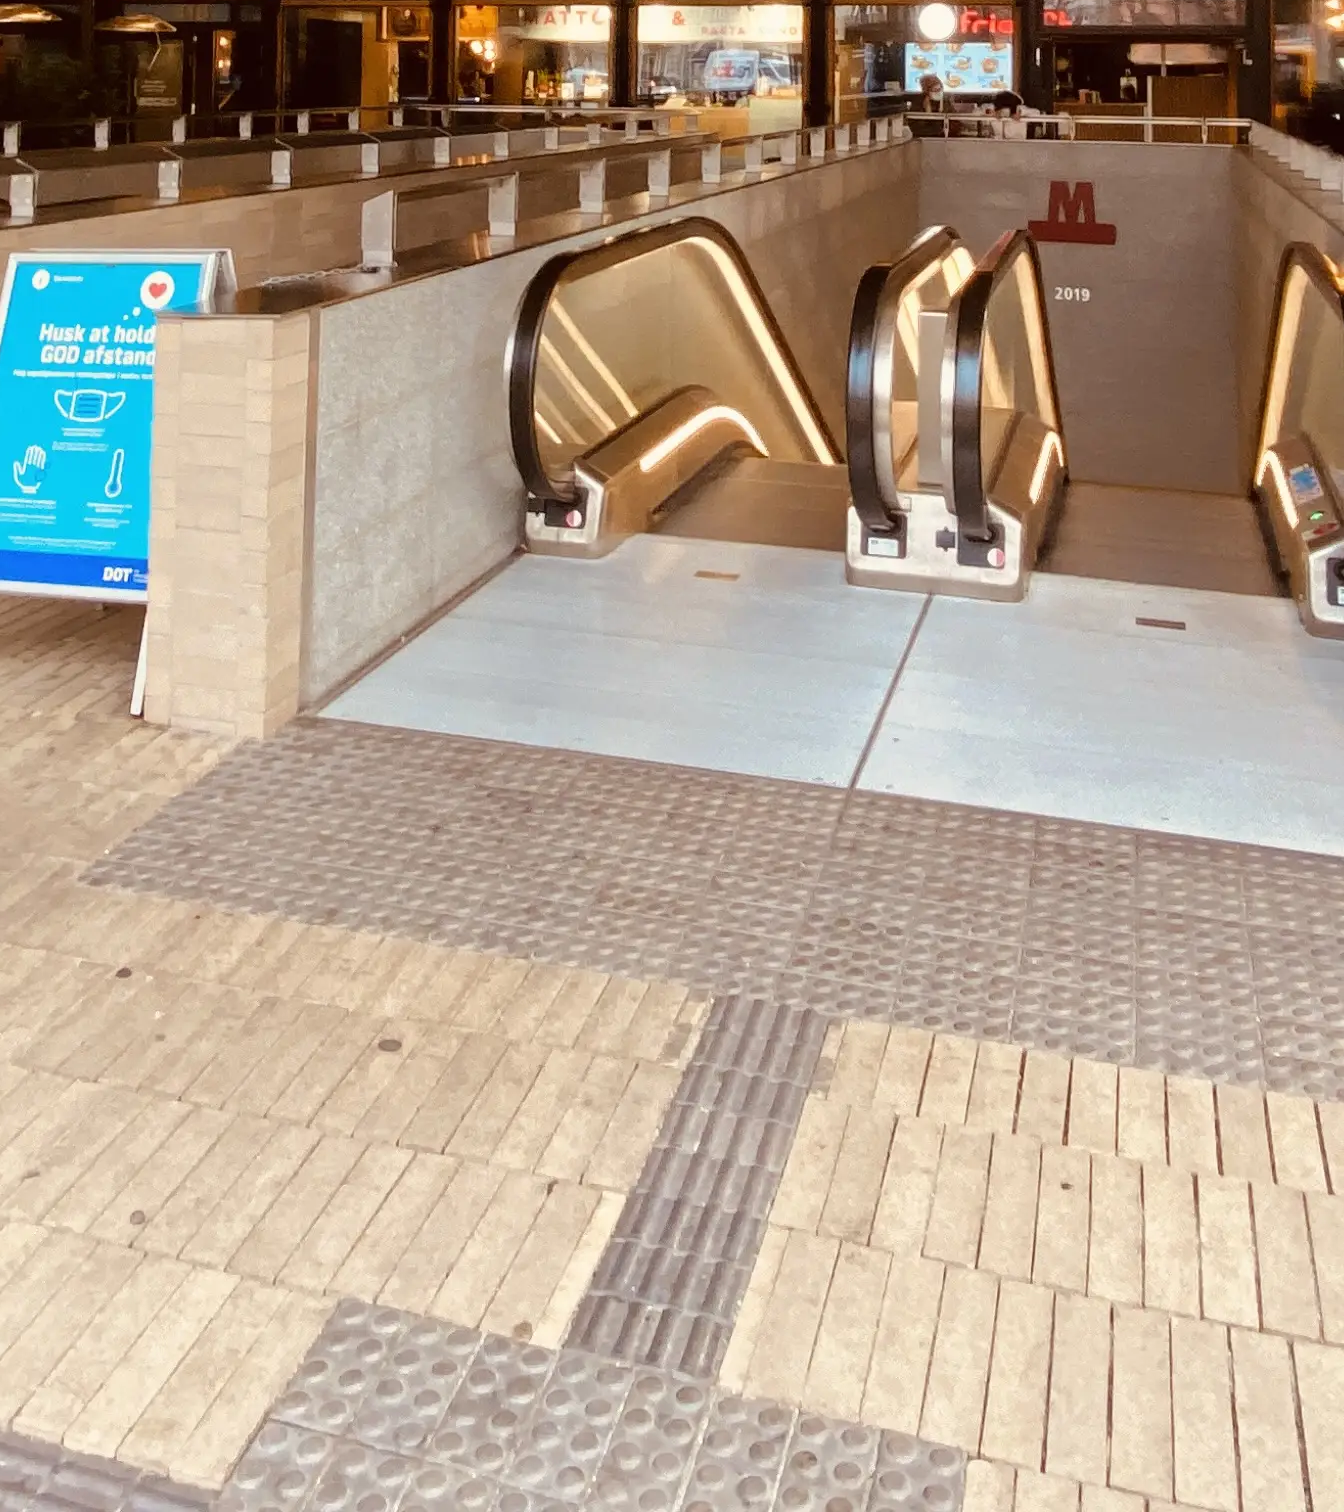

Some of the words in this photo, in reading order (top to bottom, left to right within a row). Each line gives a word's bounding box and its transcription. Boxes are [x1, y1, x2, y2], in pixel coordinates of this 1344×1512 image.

[1054, 287, 1090, 302] 2019
[39, 323, 86, 342] Husk
[88, 325, 110, 343] at
[40, 344, 80, 364] GOD
[83, 345, 155, 365] afstand
[102, 566, 133, 582] DOT
